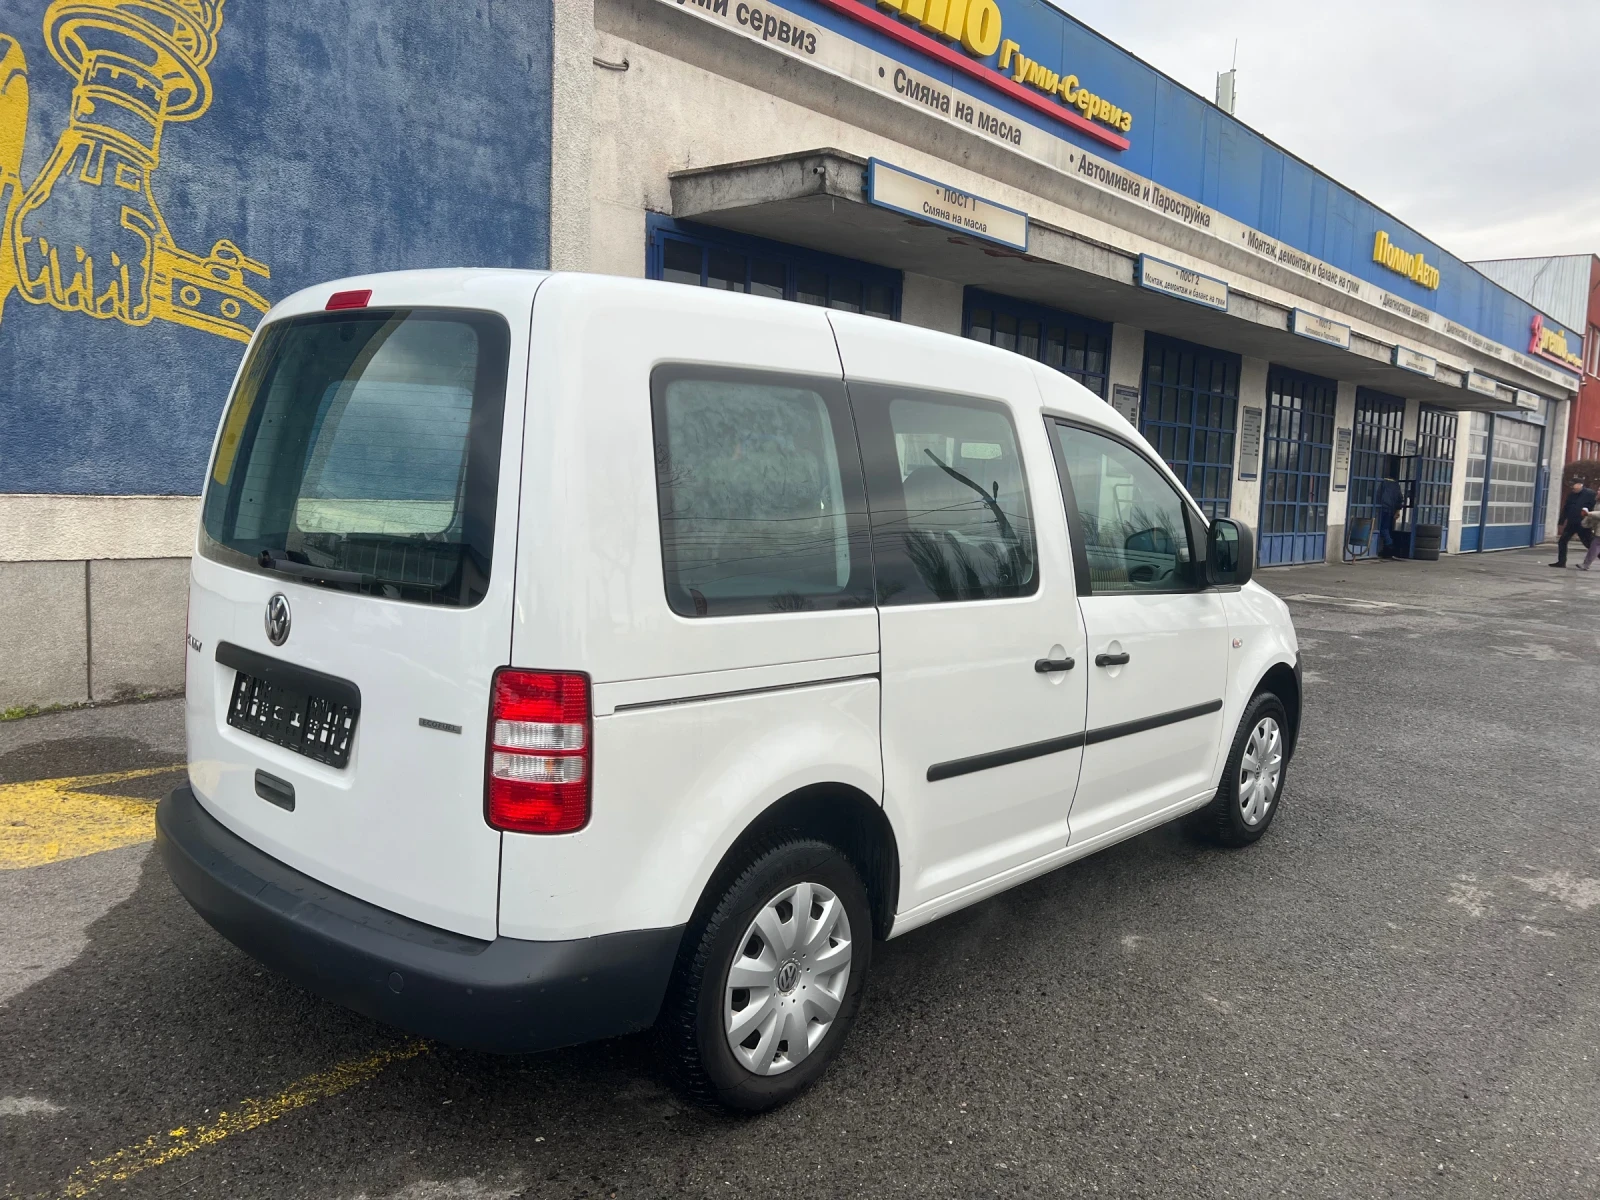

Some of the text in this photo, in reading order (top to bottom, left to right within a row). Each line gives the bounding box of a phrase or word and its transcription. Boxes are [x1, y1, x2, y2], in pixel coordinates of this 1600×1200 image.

[735, 3, 817, 54] сервиз
[893, 68, 1022, 146] Смяна на масла
[998, 39, 1132, 132] Гуми-Сервиз
[922, 201, 987, 233] Смяна на масла
[1078, 154, 1211, 228] Автомивка и Пароструйка
[1277, 249, 1312, 273] демонтаж
[1317, 263, 1339, 285] баланс
